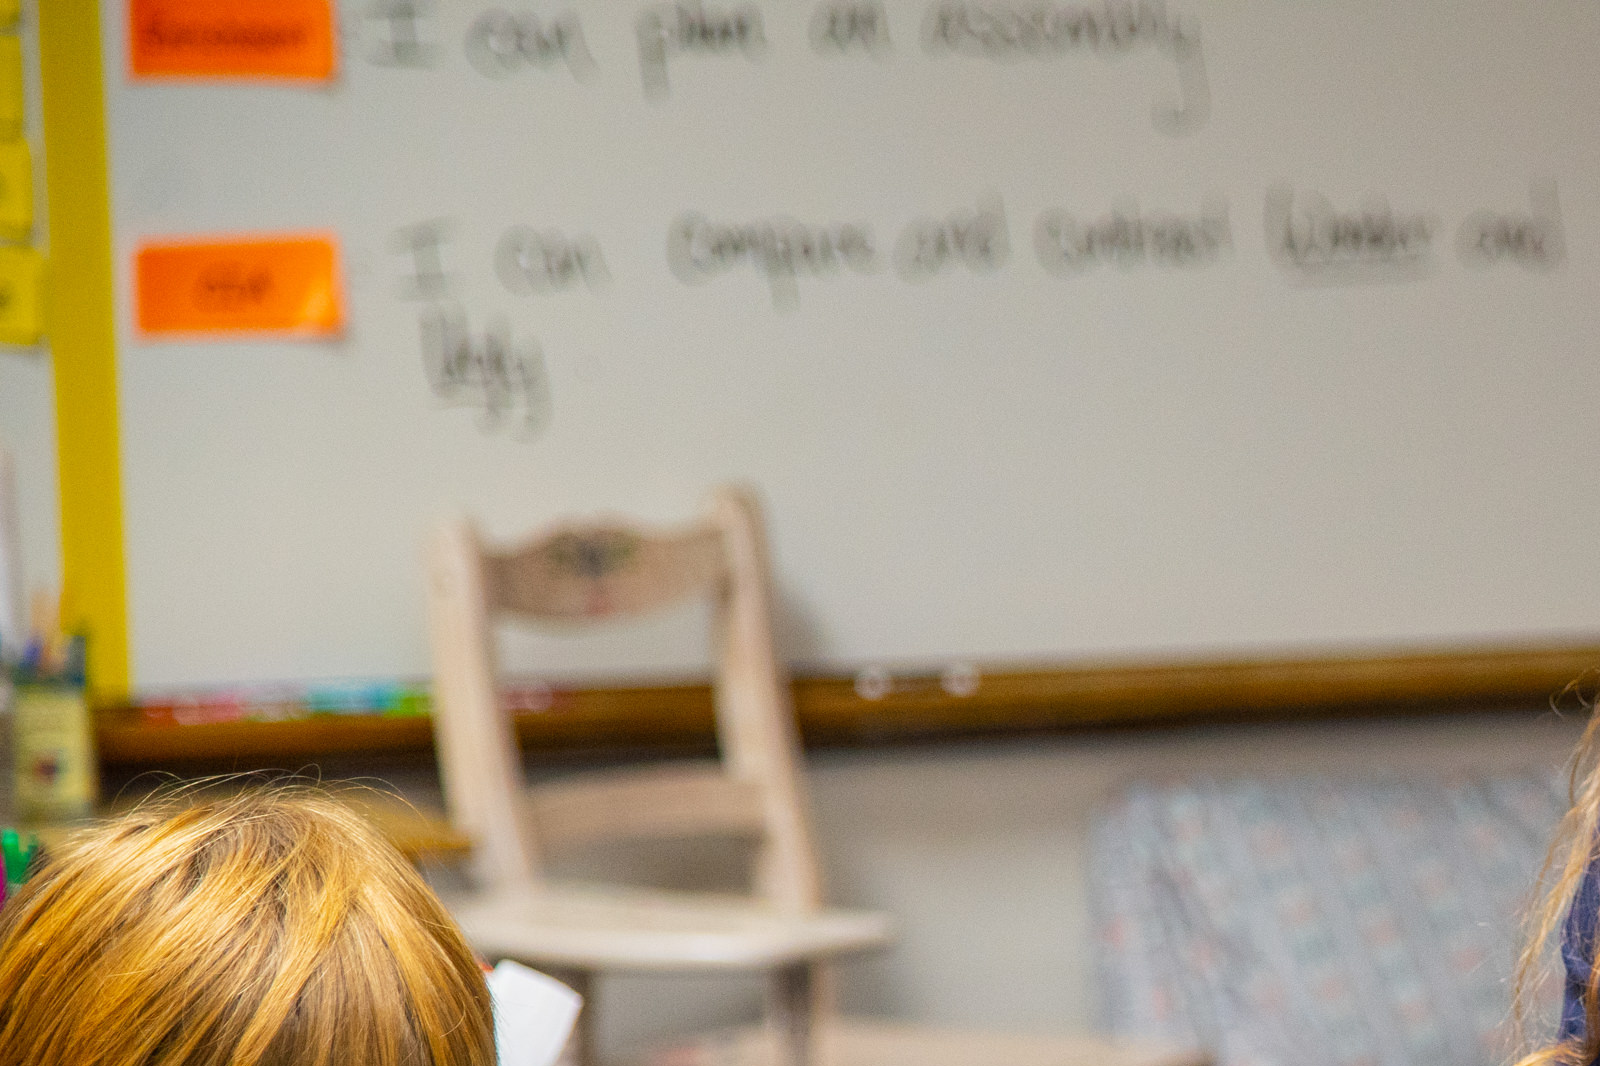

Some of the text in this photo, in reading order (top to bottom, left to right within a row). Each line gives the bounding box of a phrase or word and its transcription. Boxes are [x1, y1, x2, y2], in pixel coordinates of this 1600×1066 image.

[468, 9, 594, 80] can
[396, 220, 458, 300] I
[496, 226, 606, 293] can
[896, 194, 1007, 281] and
[1458, 178, 1563, 270] and
